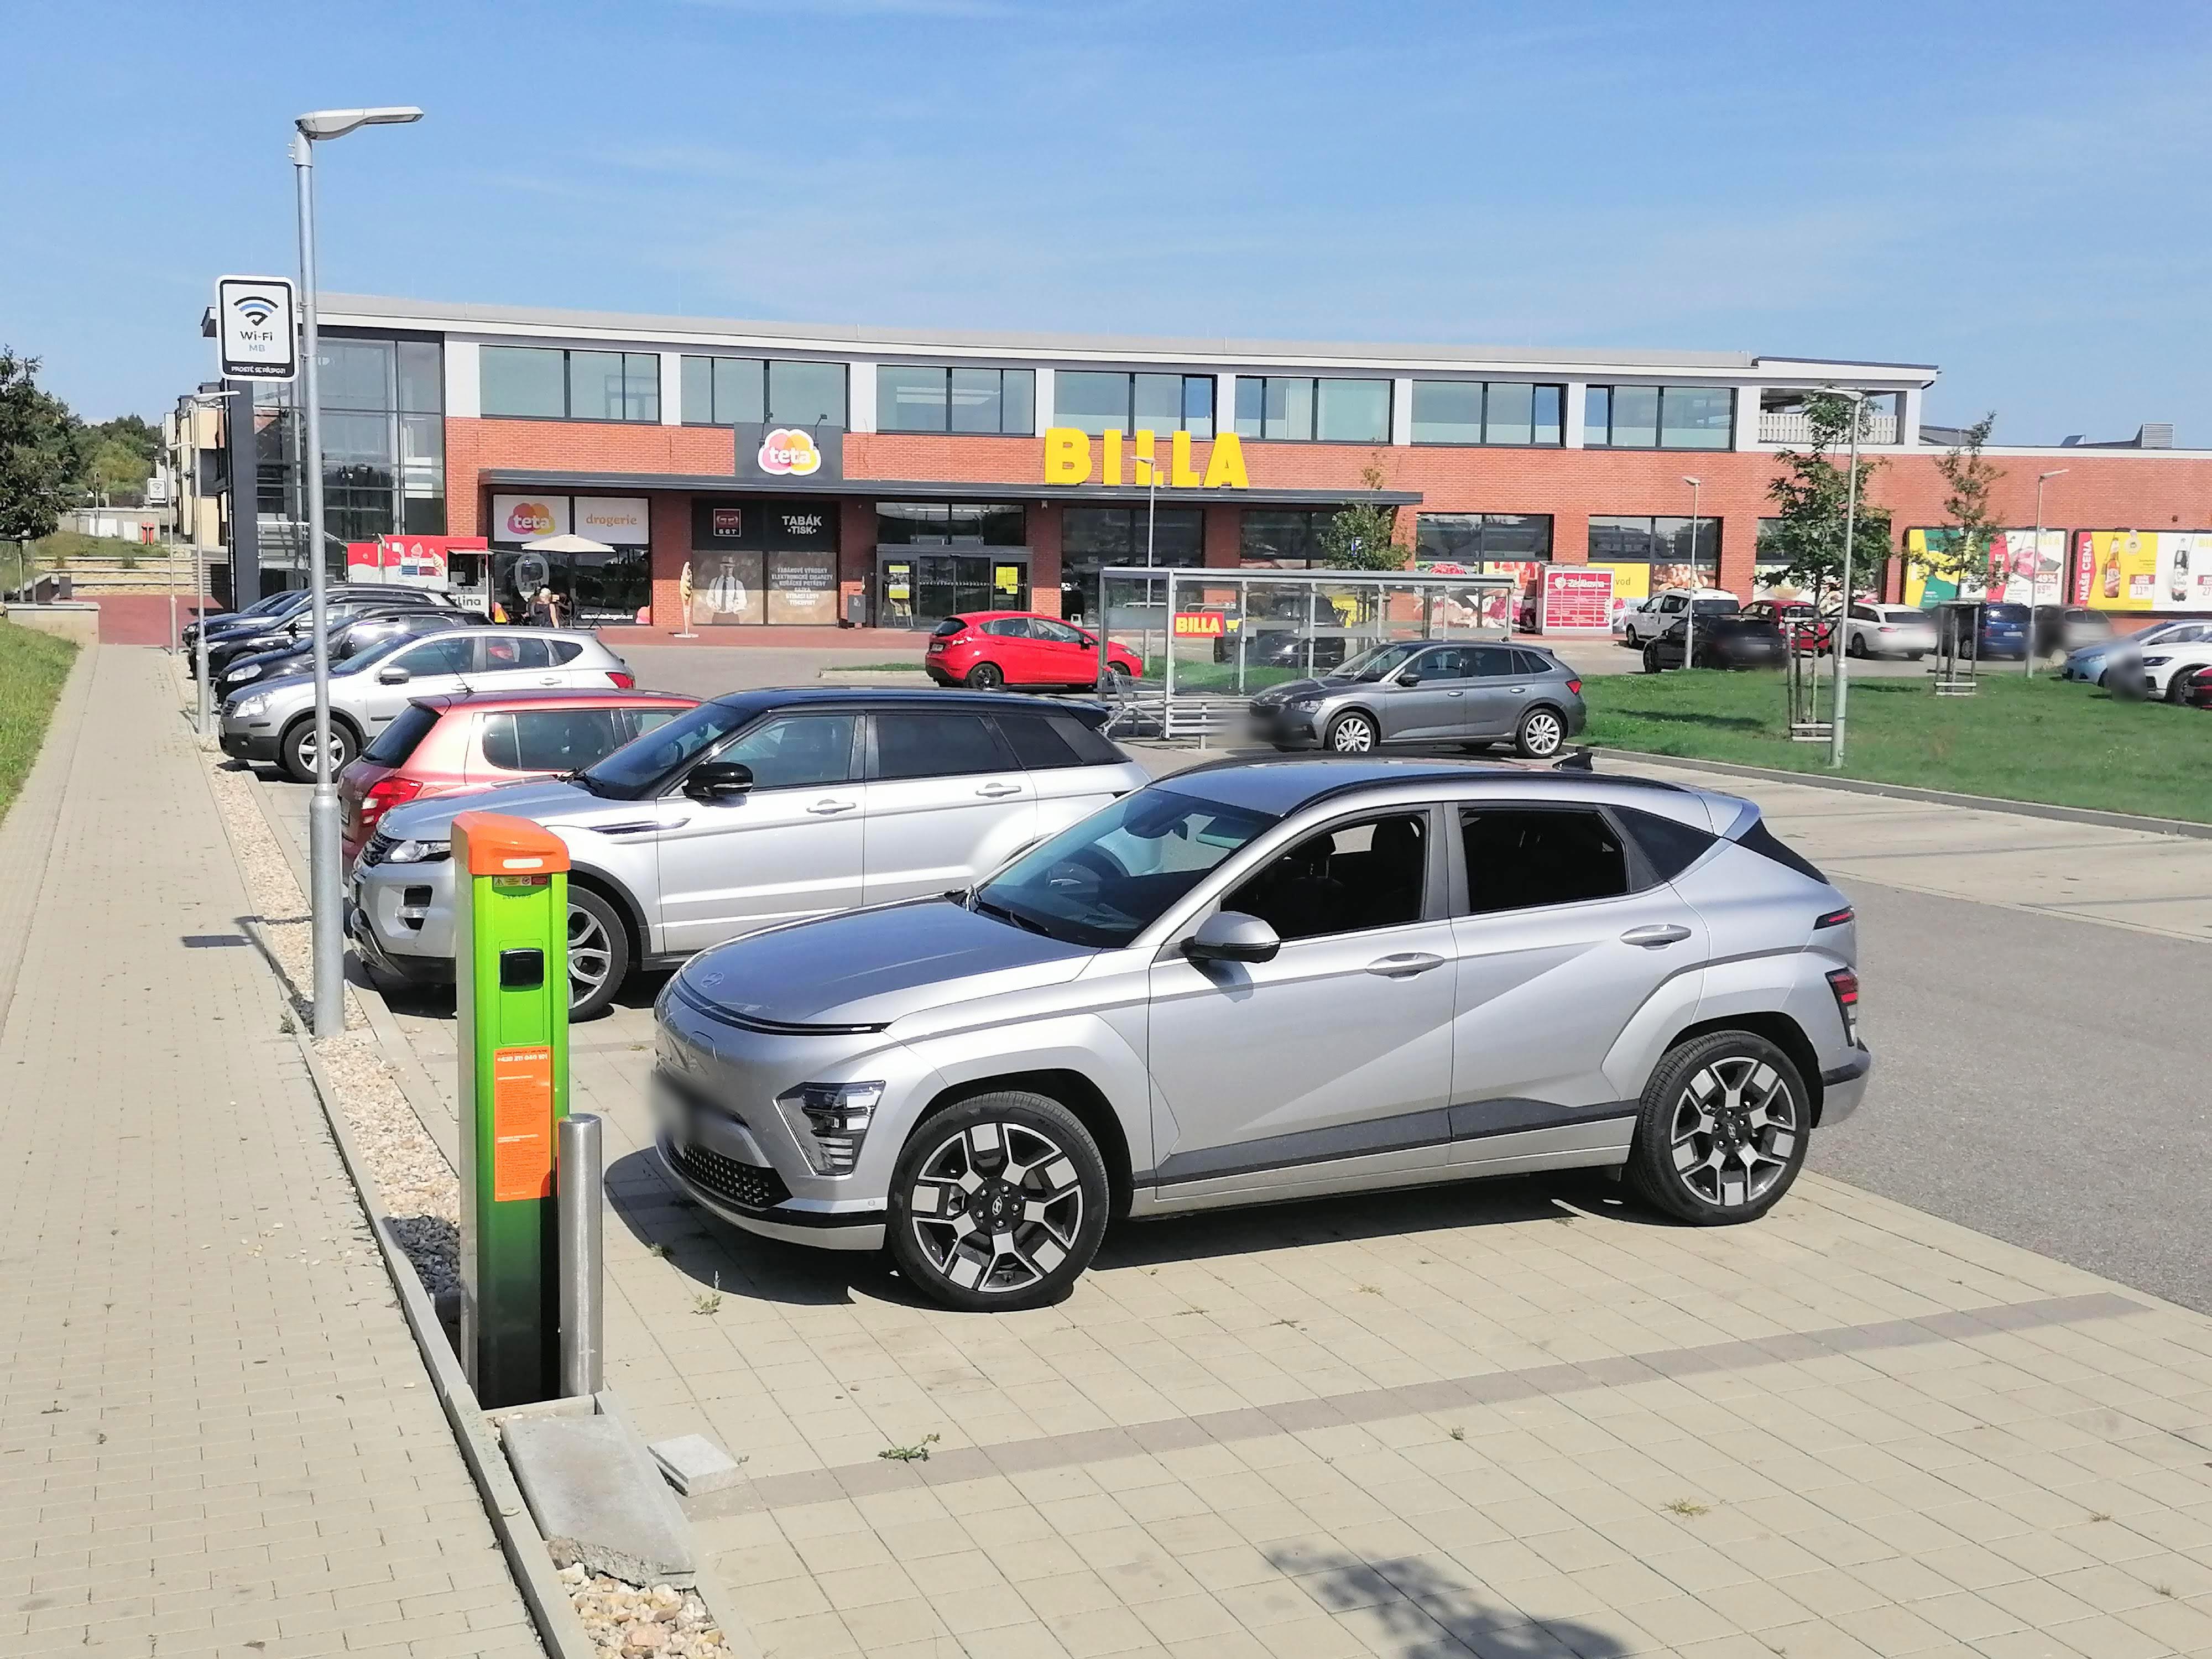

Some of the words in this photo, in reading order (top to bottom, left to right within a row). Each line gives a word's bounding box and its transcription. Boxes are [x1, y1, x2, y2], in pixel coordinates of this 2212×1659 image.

[239, 331, 273, 341] Wi-Fi
[769, 446, 810, 464] teta
[1045, 427, 1249, 487] BILLA
[513, 514, 549, 529] teta
[586, 514, 637, 526] drogerie
[781, 514, 822, 526] TABÁK
[2081, 539, 2093, 571] CENA
[1615, 577, 1631, 586] vod
[2079, 572, 2090, 601] NAŠE
[1176, 617, 1221, 633] BILLA
